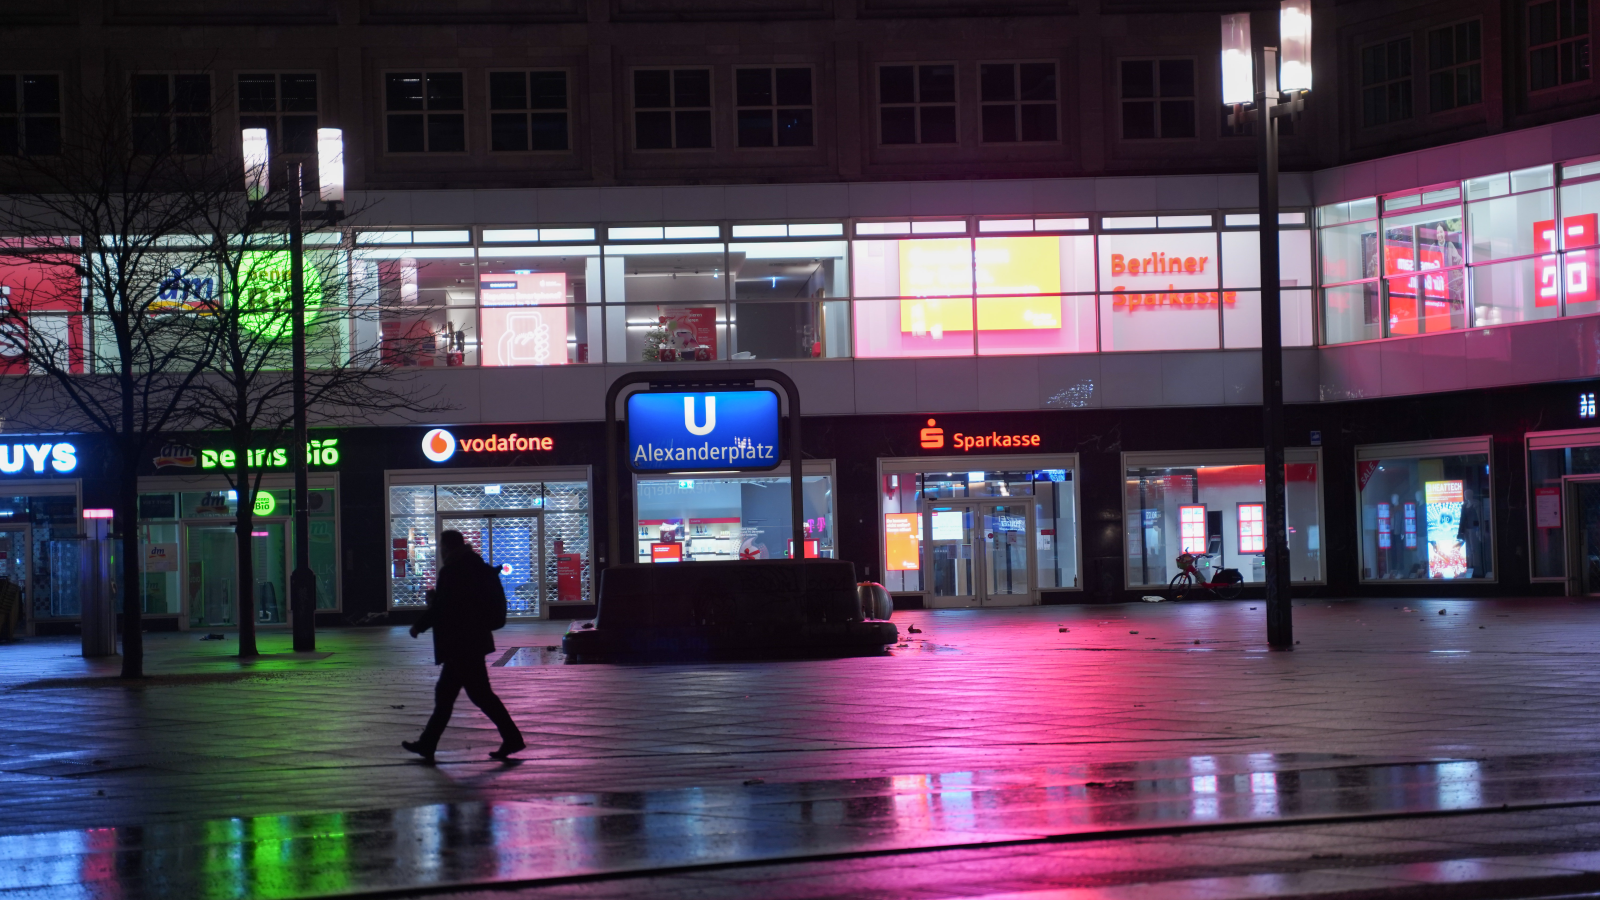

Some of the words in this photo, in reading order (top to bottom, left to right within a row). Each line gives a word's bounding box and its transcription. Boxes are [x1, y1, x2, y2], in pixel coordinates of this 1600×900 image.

[1111, 252, 1208, 273] Berliner
[158, 268, 214, 300] dm
[1113, 284, 1236, 311] Sparkasse
[684, 396, 716, 436] U
[460, 434, 553, 452] vodafone
[953, 432, 1041, 451] Sparkasse
[0, 442, 77, 473] UYS
[634, 442, 774, 463] Alexanderplatz
[1360, 461, 1376, 484] SALE
[1432, 482, 1462, 491] HEATTECH
[202, 491, 226, 506] dm
[151, 546, 165, 555] dm
